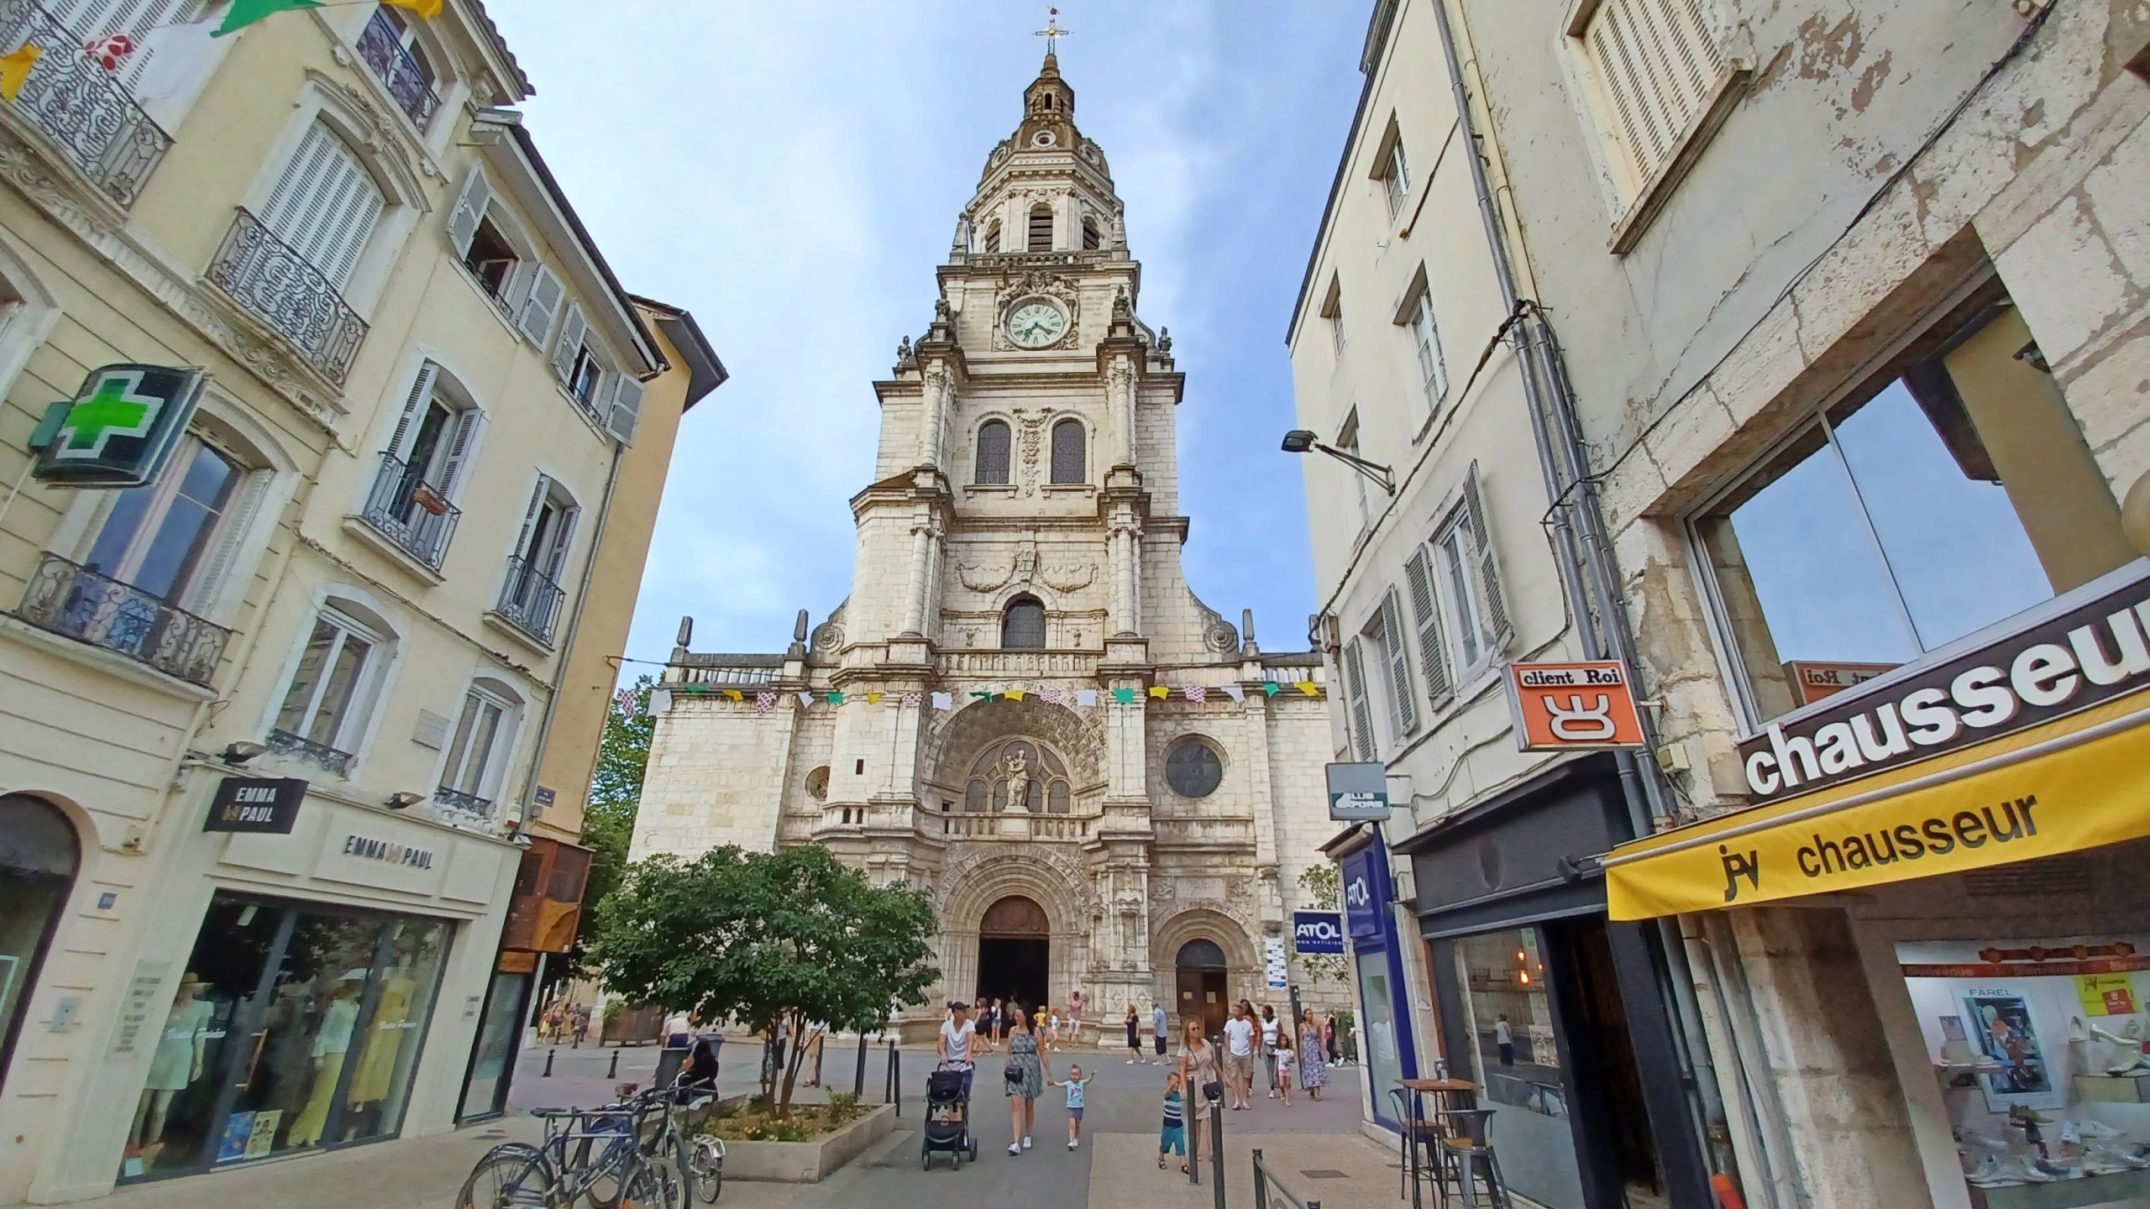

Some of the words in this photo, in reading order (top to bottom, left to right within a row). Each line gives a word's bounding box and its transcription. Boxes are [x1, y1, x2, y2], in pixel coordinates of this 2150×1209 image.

[1523, 671, 1575, 685] client
[1584, 668, 1621, 684] Roi
[1746, 598, 2150, 796] chausseu
[236, 787, 277, 803] EMMA
[238, 806, 273, 823] PAUL
[1796, 794, 2038, 878] chausseur
[343, 835, 387, 861] EMMA
[402, 847, 433, 870] PAUL
[1347, 876, 1370, 906] ATOL
[1296, 921, 1341, 940] ATOL
[1969, 988, 2014, 997] FAREL
